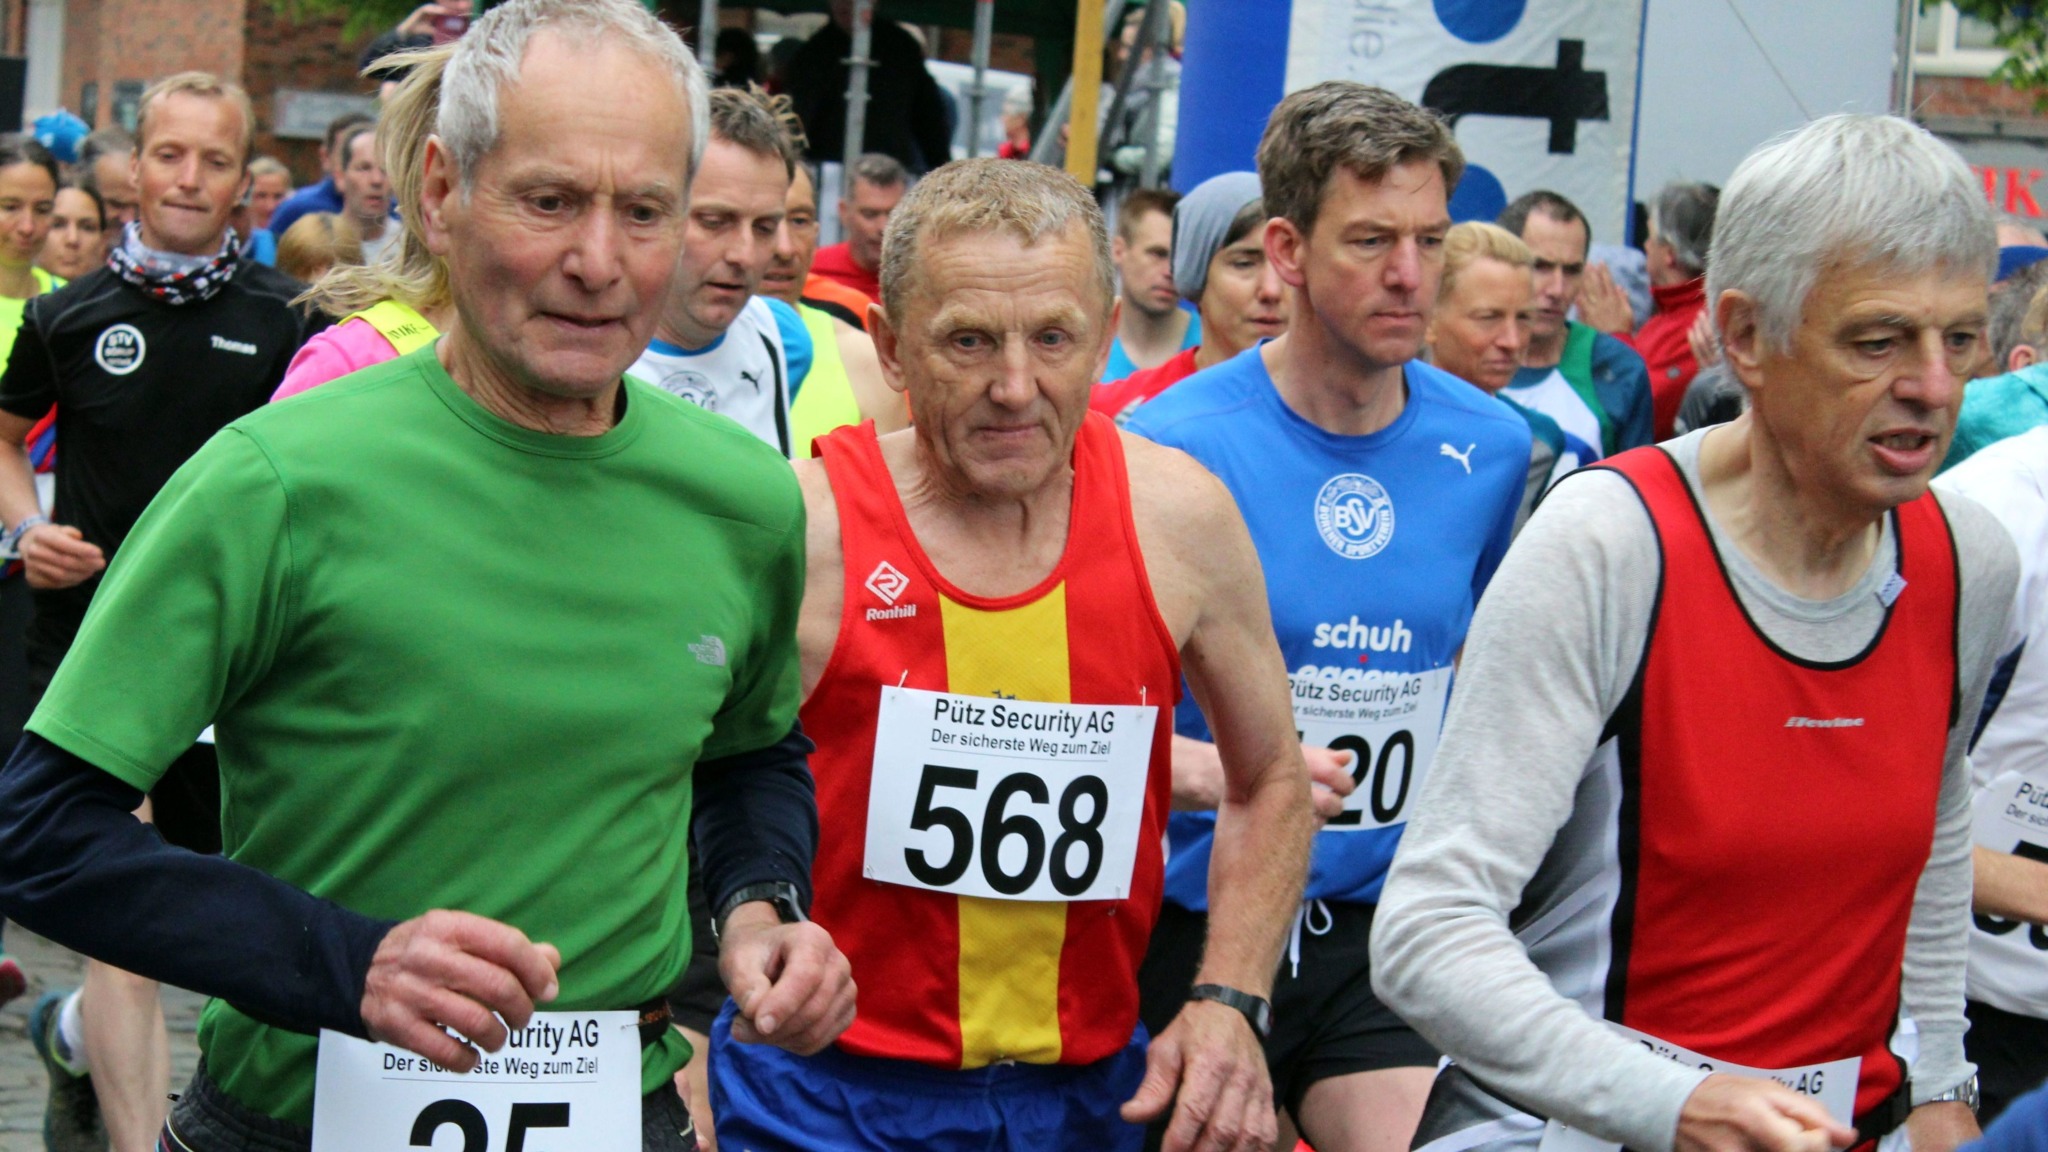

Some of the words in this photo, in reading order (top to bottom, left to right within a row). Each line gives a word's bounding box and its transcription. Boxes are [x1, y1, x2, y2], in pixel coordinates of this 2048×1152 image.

[211, 335, 257, 355] Thomas
[1334, 498, 1376, 536] BSV
[866, 604, 917, 621] Ronhill
[1312, 615, 1412, 654] schuh
[1329, 684, 1399, 705] Security
[1401, 678, 1421, 697] AG
[934, 698, 985, 726] Pütz
[991, 705, 1082, 738] Security
[1085, 711, 1115, 734] AG
[1302, 704, 1355, 719] sicherste
[1358, 708, 1380, 721] Weg
[1383, 707, 1400, 718] zum
[1402, 701, 1418, 714] Ziel
[931, 728, 957, 745] Der
[960, 732, 1026, 752] sicherste
[1029, 737, 1058, 756] Weg
[1061, 743, 1087, 755] zum
[1090, 741, 1112, 755] Ziel
[1297, 729, 1414, 825] 20
[904, 764, 1108, 896] 568
[568, 1019, 599, 1048] AG
[383, 1053, 414, 1072] Der
[504, 1058, 539, 1079] Weg
[543, 1060, 573, 1075] zum
[576, 1056, 599, 1074] Ziel
[1795, 1070, 1825, 1095] AG
